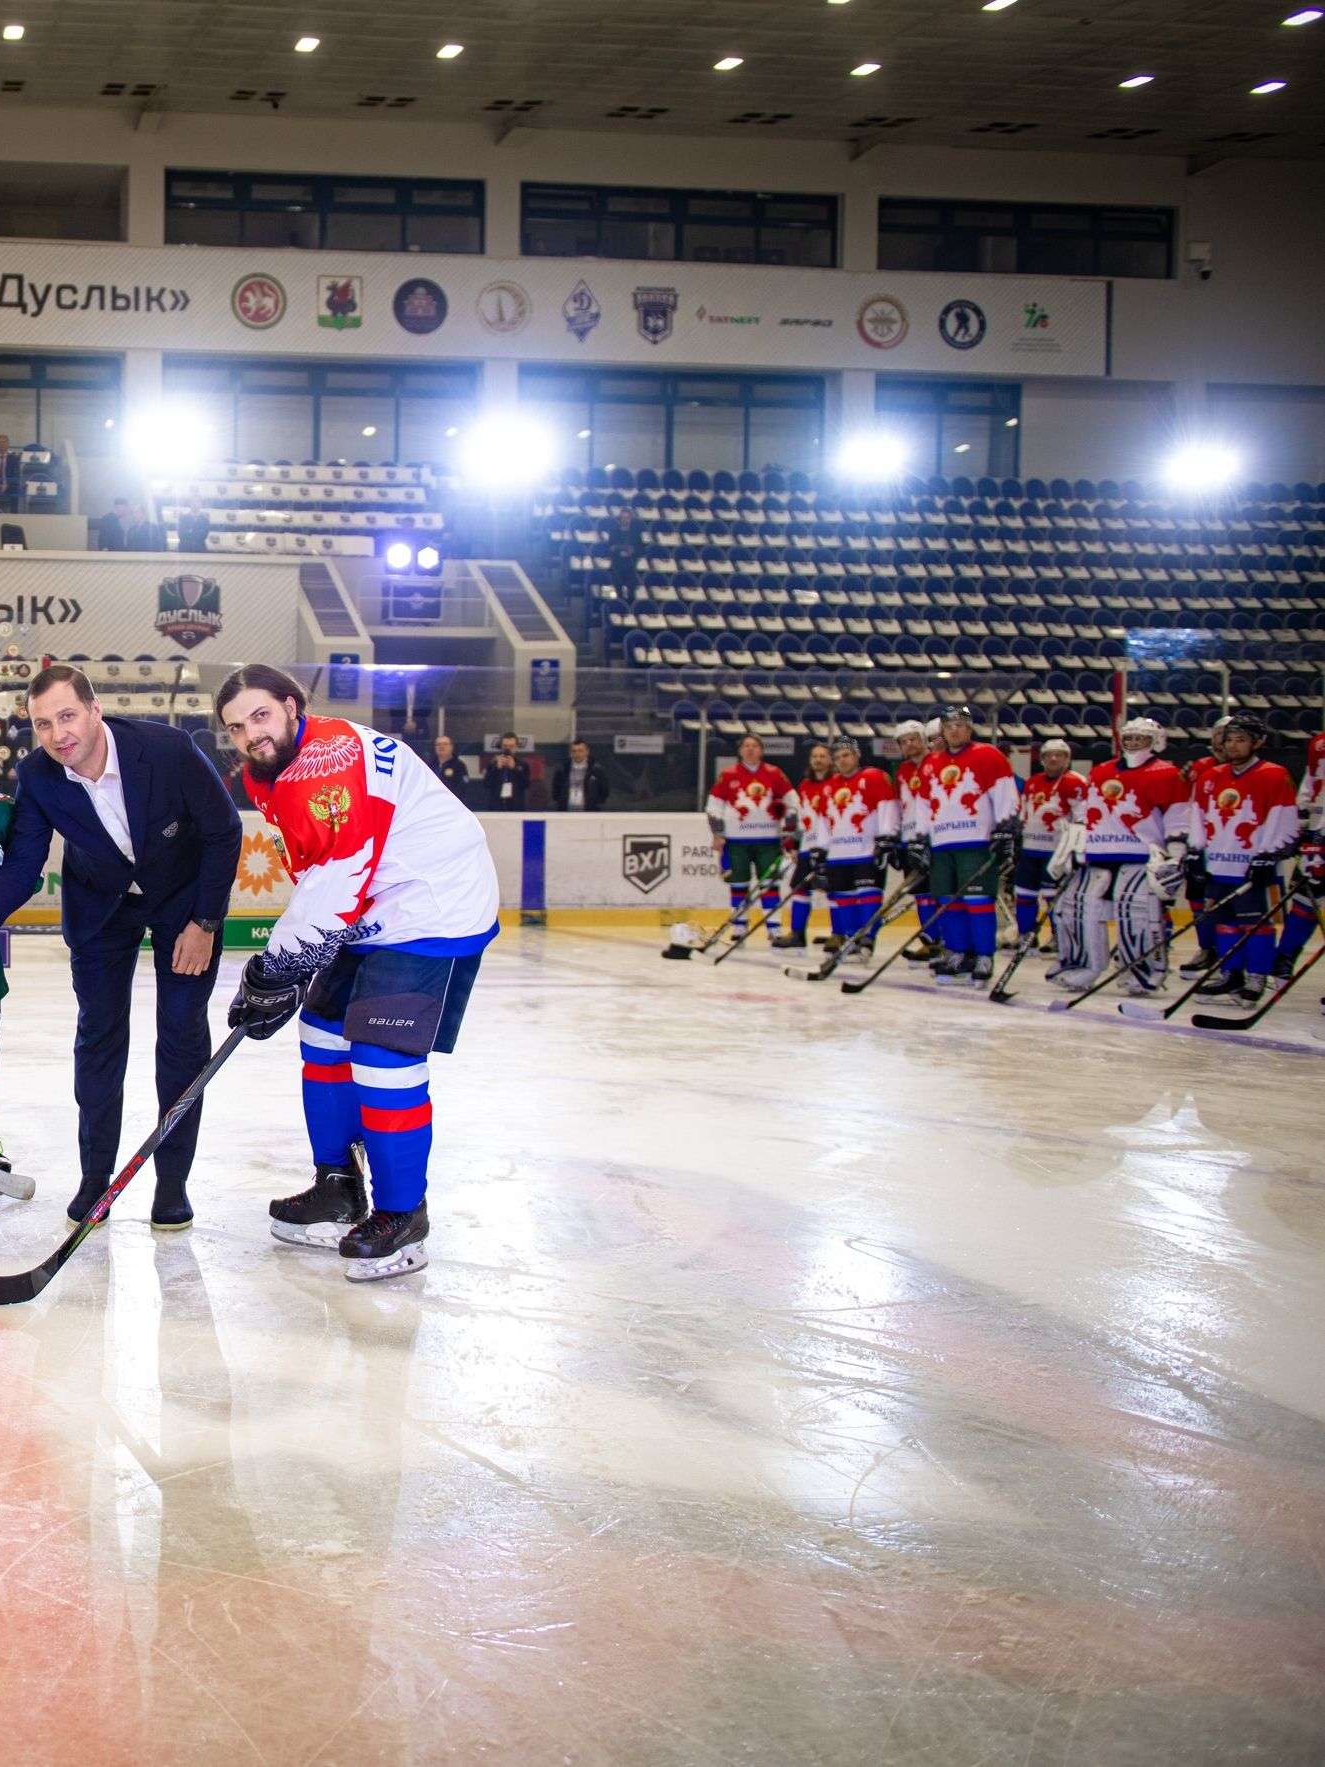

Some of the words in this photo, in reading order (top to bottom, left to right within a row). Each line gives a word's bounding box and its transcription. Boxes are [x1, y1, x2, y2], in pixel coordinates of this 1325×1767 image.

[626, 848, 670, 878] ВХЛ
[682, 864, 717, 876] КУБО
[248, 991, 295, 1005] CCM
[367, 1016, 415, 1028] BAUER
